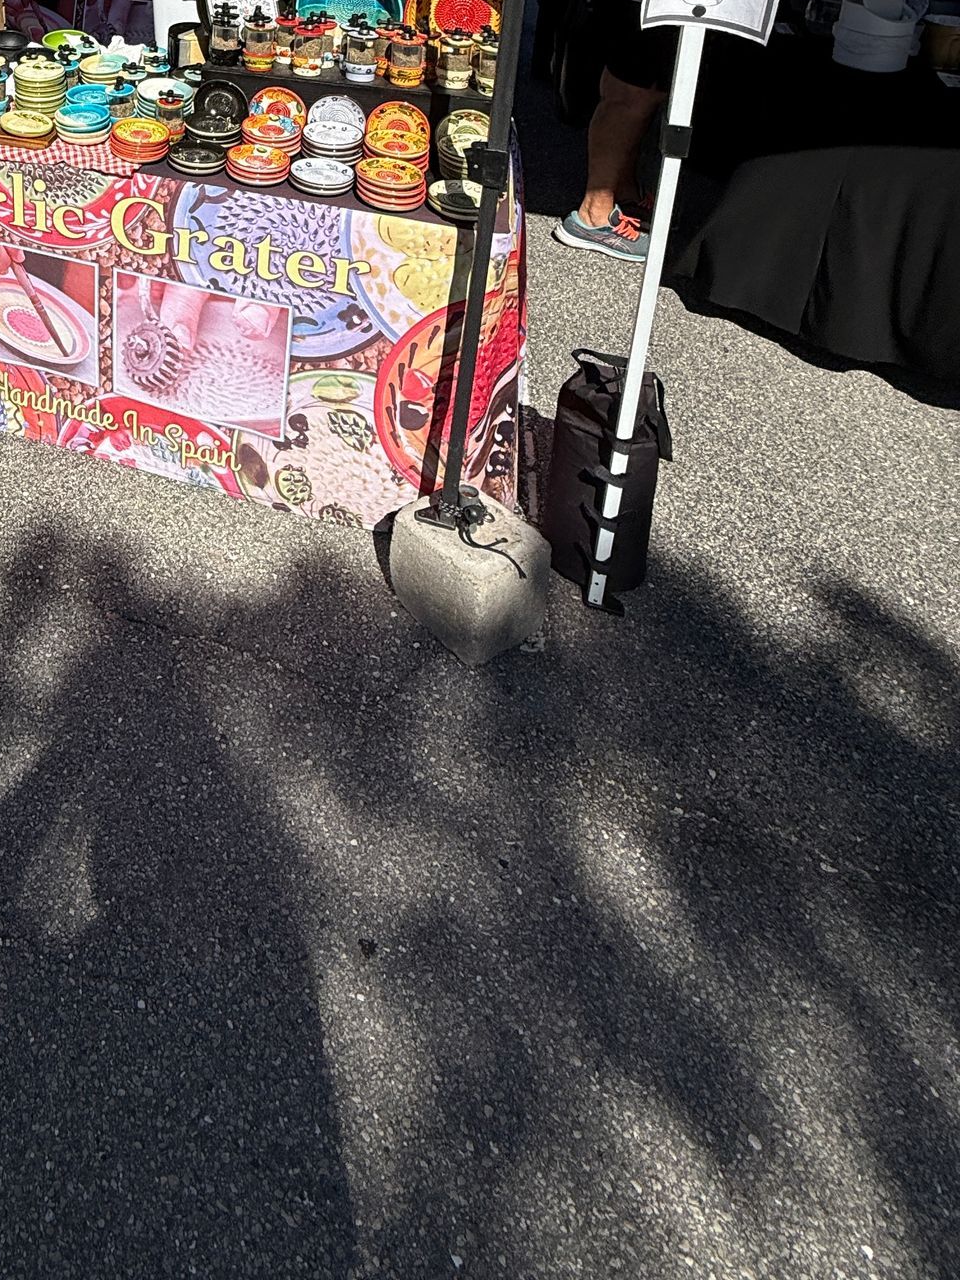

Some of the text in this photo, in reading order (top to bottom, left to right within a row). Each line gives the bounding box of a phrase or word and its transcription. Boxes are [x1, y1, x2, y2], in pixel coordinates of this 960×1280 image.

[109, 196, 372, 298] Grater
[123, 410, 159, 446] In
[164, 423, 242, 471] Spain
